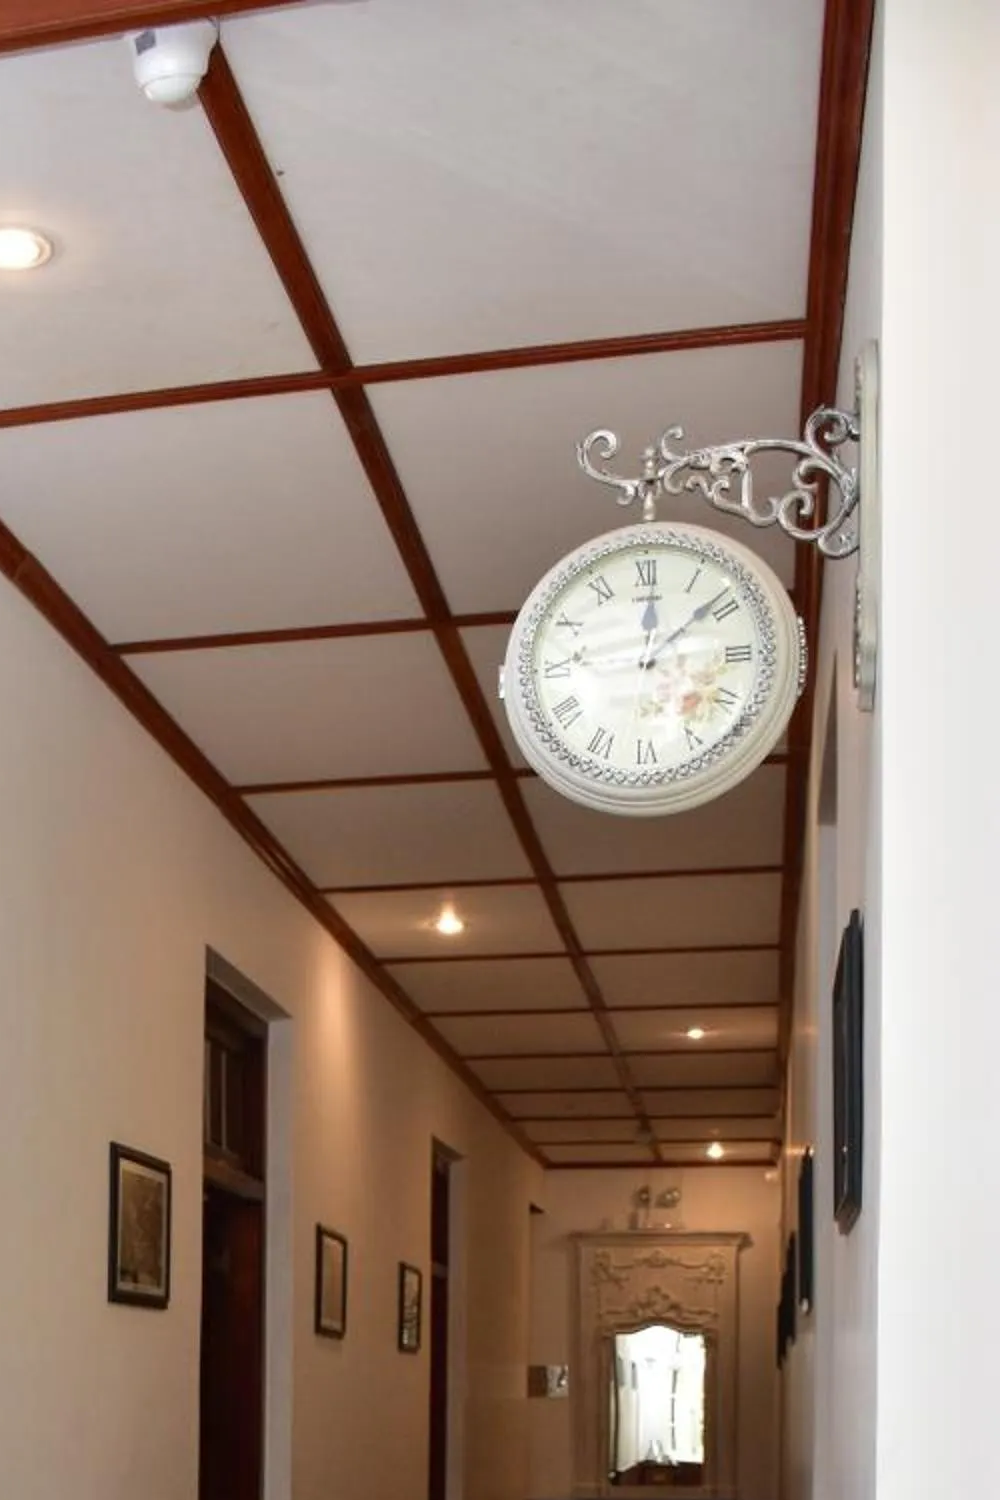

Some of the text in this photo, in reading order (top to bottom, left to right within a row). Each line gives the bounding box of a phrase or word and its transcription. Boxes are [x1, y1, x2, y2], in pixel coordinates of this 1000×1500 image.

[635, 559, 657, 586] XII
[685, 568, 701, 592] I
[588, 576, 615, 606] XI
[712, 599, 739, 621] II
[556, 611, 584, 636] X
[725, 645, 751, 662] III
[551, 696, 584, 730] VIII
[587, 727, 615, 759] VII
[636, 739, 657, 764] VI
